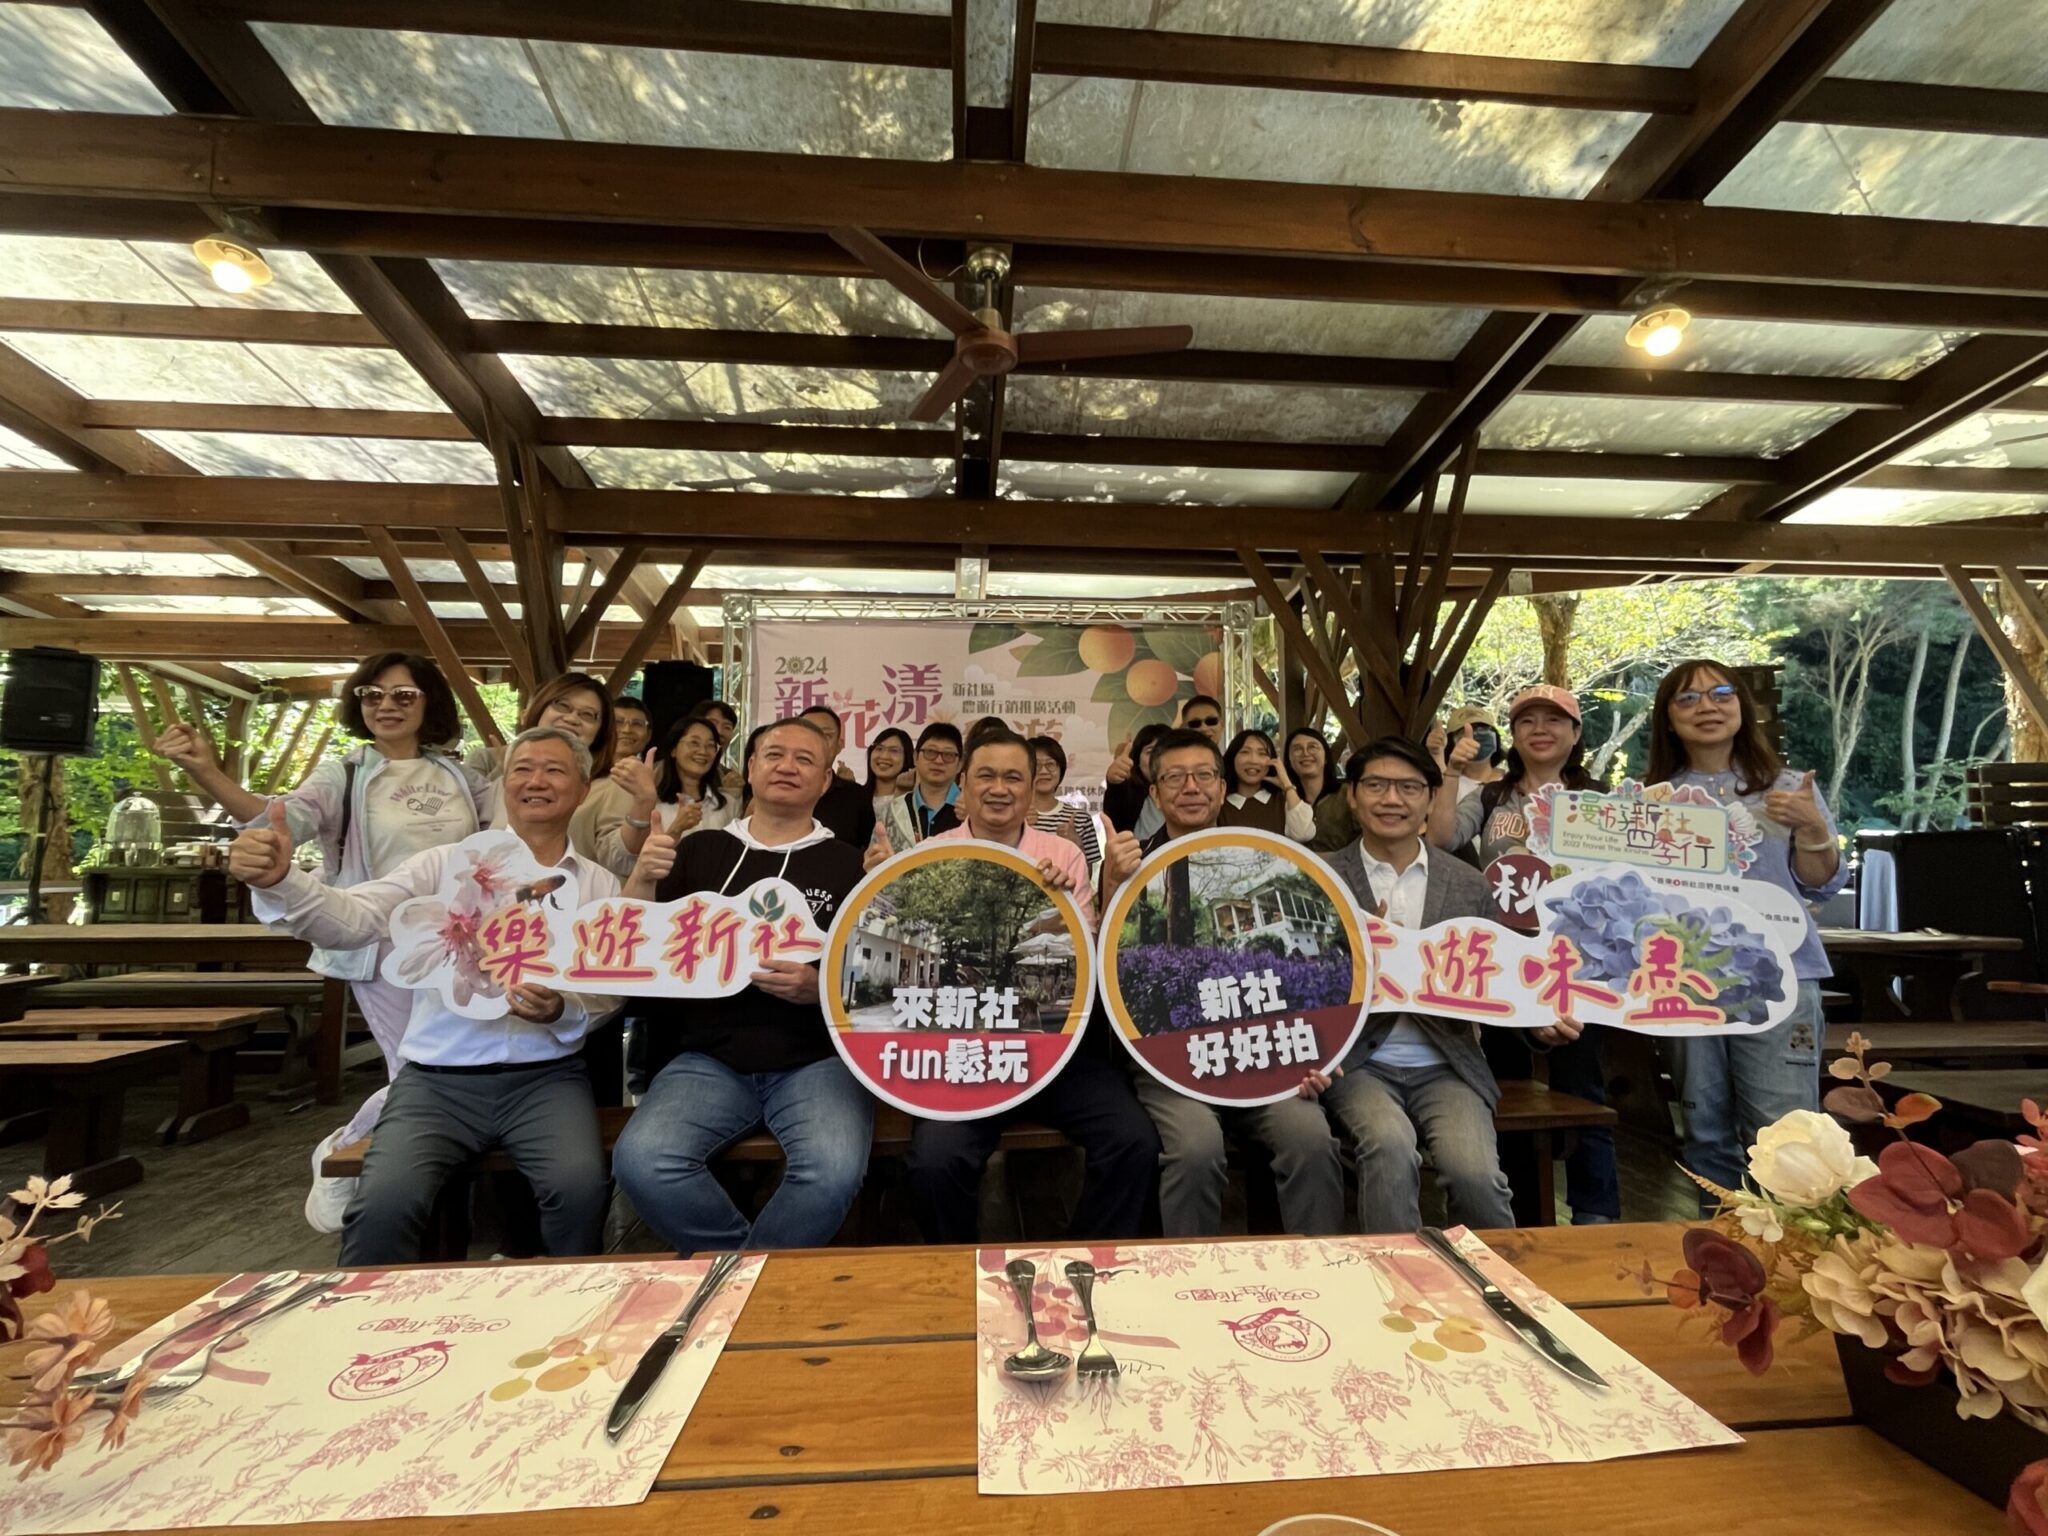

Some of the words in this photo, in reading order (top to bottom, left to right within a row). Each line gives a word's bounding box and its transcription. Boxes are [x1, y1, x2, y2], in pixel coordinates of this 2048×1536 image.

[774, 656, 829, 675] 2024
[952, 683, 995, 697] 新社區
[1626, 827, 1715, 869] 四季行
[805, 888, 833, 902] UESS
[1492, 861, 1548, 914] 秋
[480, 899, 824, 986] 樂遊新社
[892, 985, 1020, 1030] 來新社
[1197, 968, 1288, 1023] 新社
[879, 1039, 1030, 1085] fun鬆玩
[1187, 1017, 1321, 1081] 好好拍
